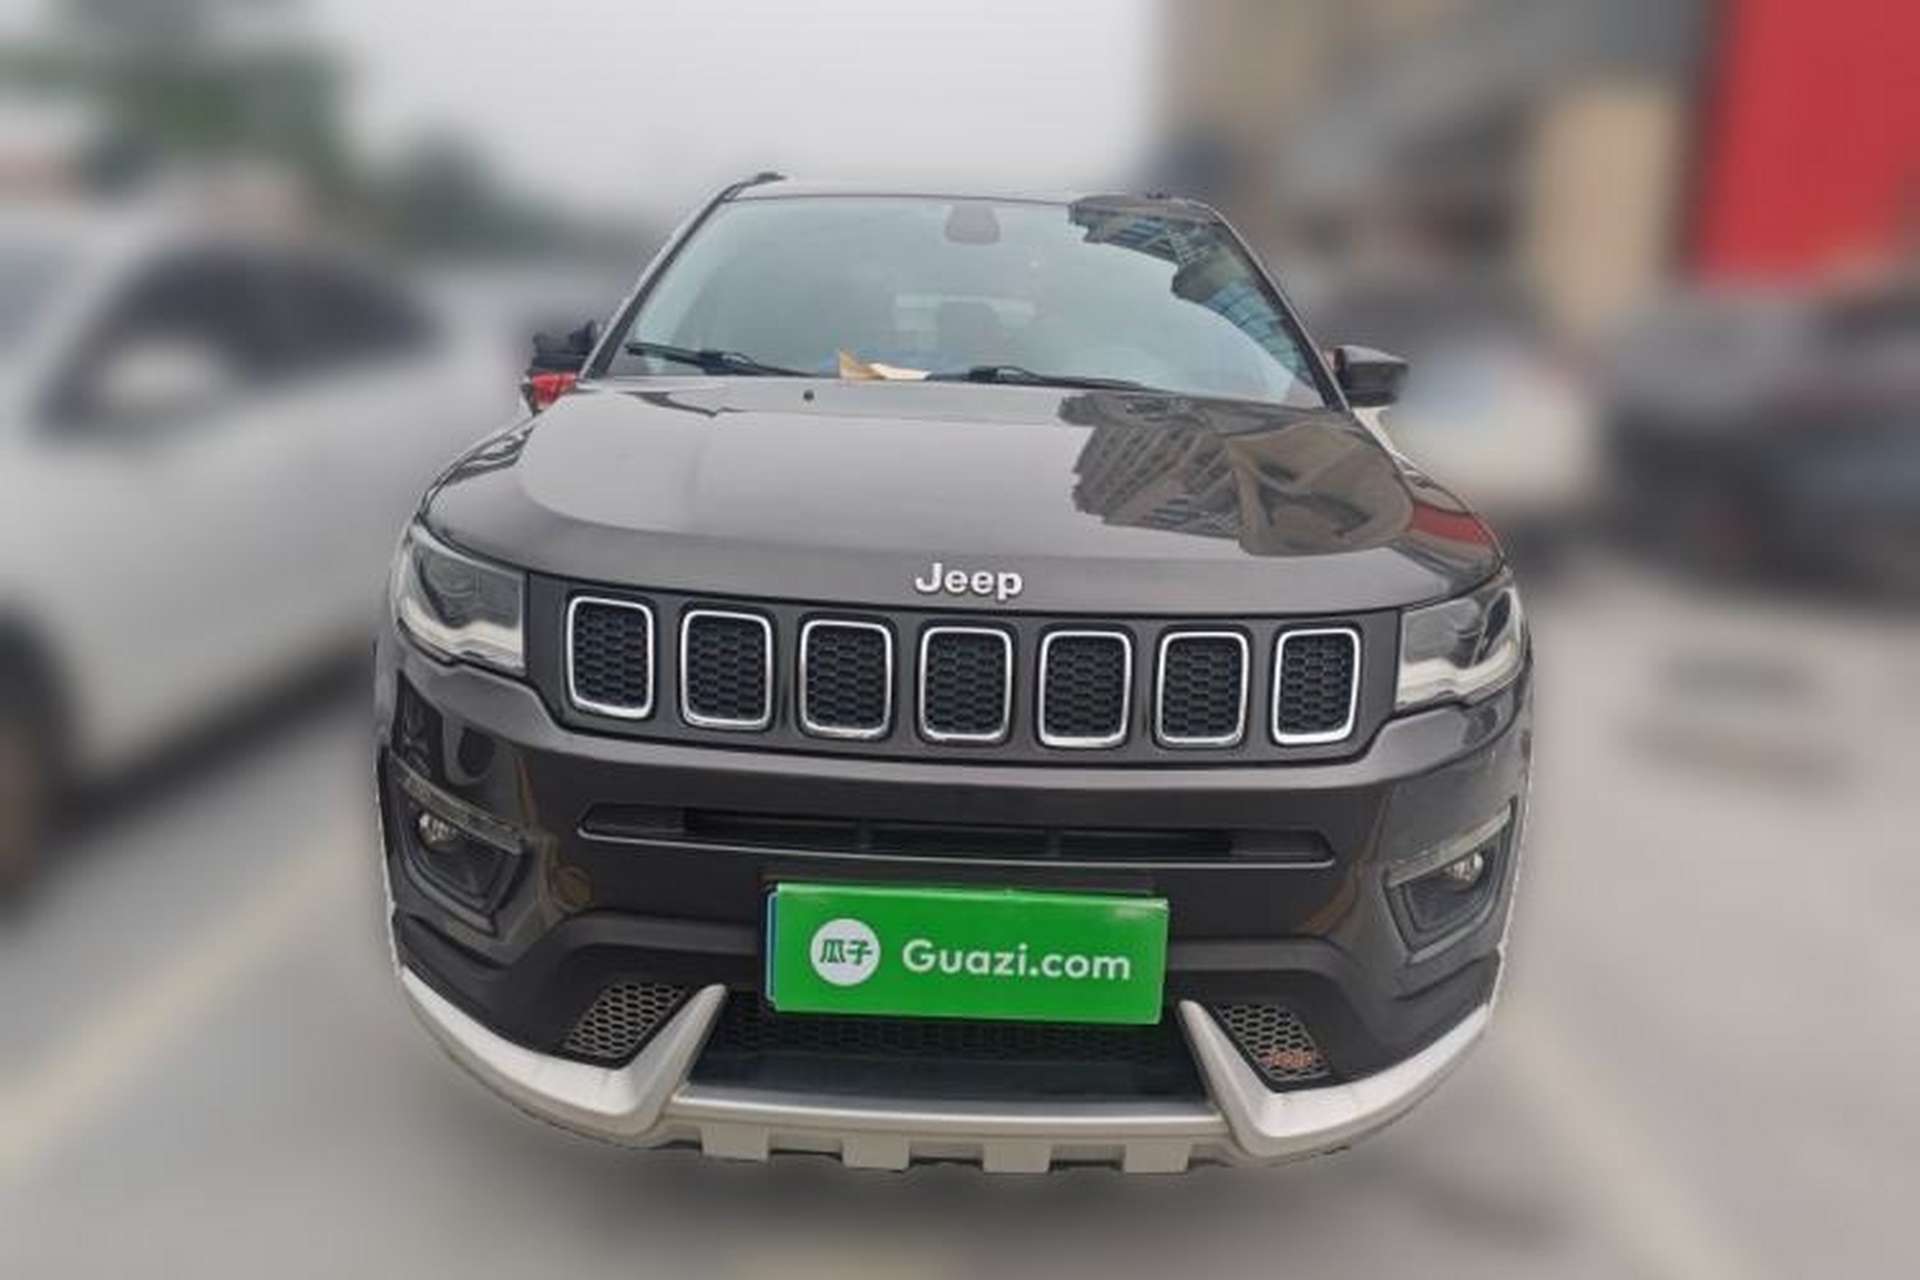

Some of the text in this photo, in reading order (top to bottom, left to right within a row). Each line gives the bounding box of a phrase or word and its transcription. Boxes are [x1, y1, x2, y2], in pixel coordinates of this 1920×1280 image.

[914, 562, 1023, 601] Jeep
[819, 938, 873, 965] 瓜子
[902, 938, 1131, 980] Guazi.com
